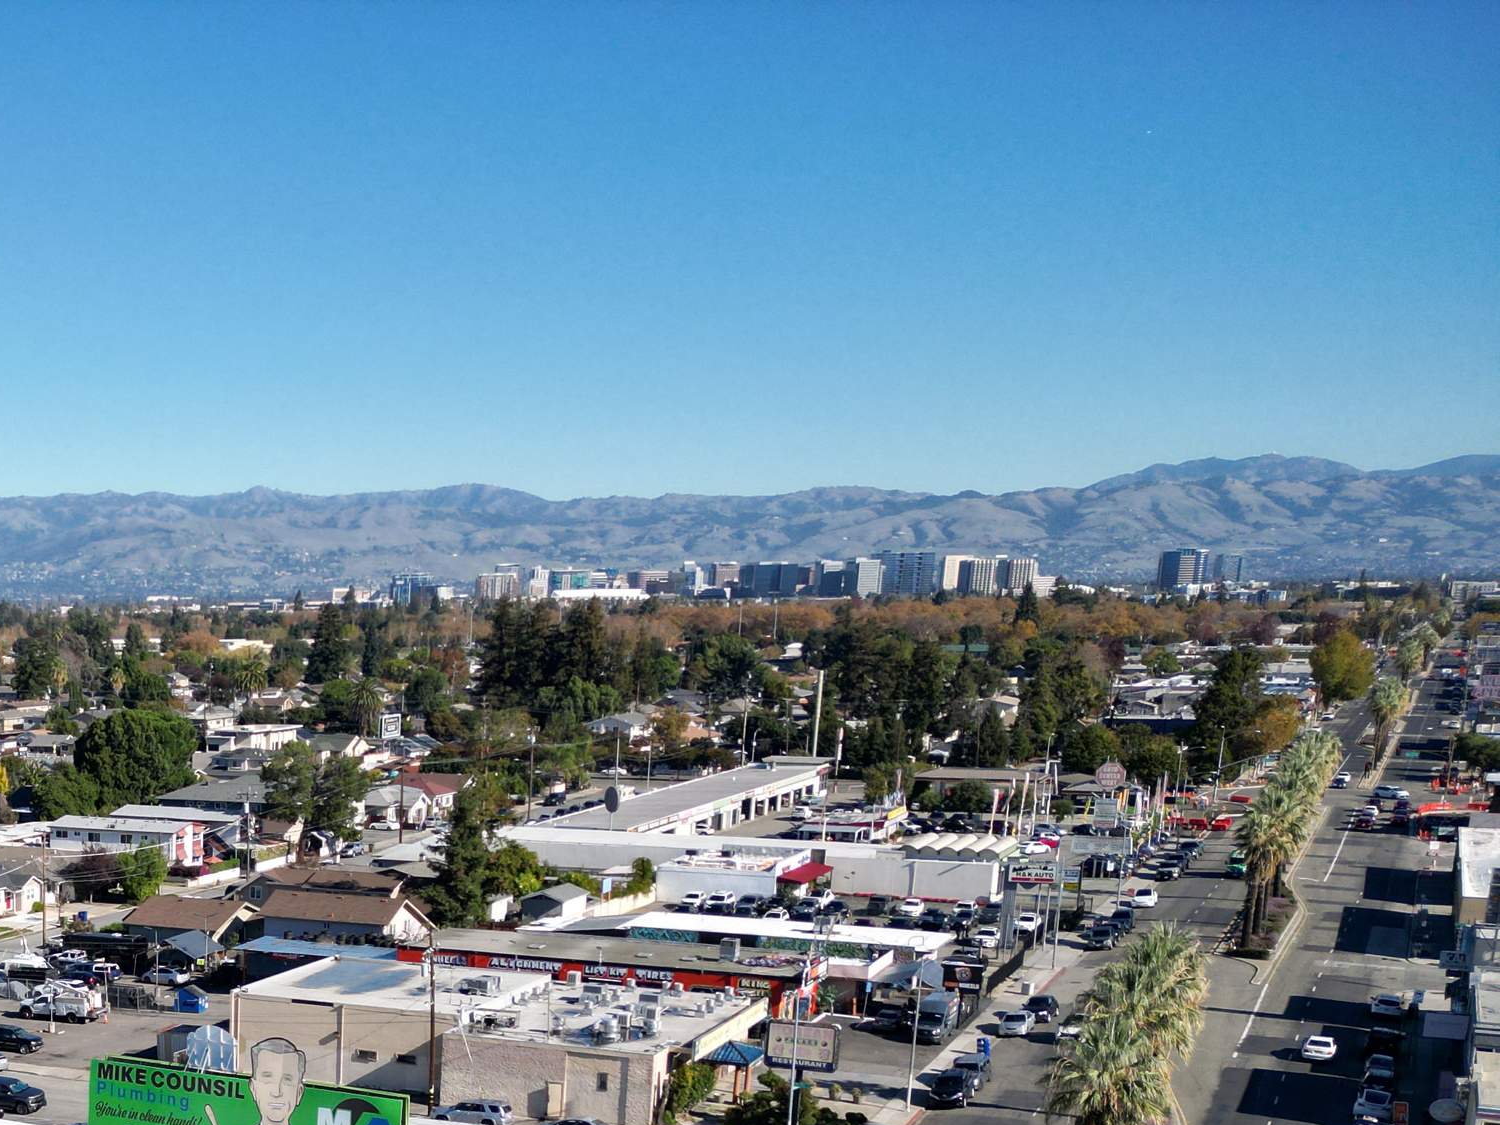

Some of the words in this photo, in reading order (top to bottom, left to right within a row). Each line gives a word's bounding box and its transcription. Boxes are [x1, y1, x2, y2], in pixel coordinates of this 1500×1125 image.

[772, 1057, 828, 1068] RESTAURANT
[97, 1062, 147, 1085] MIKE
[151, 1072, 245, 1099] COUNSIL
[96, 1080, 190, 1112] Plumbing
[95, 1100, 127, 1119] You're
[128, 1108, 139, 1120] in
[139, 1107, 166, 1124] clean
